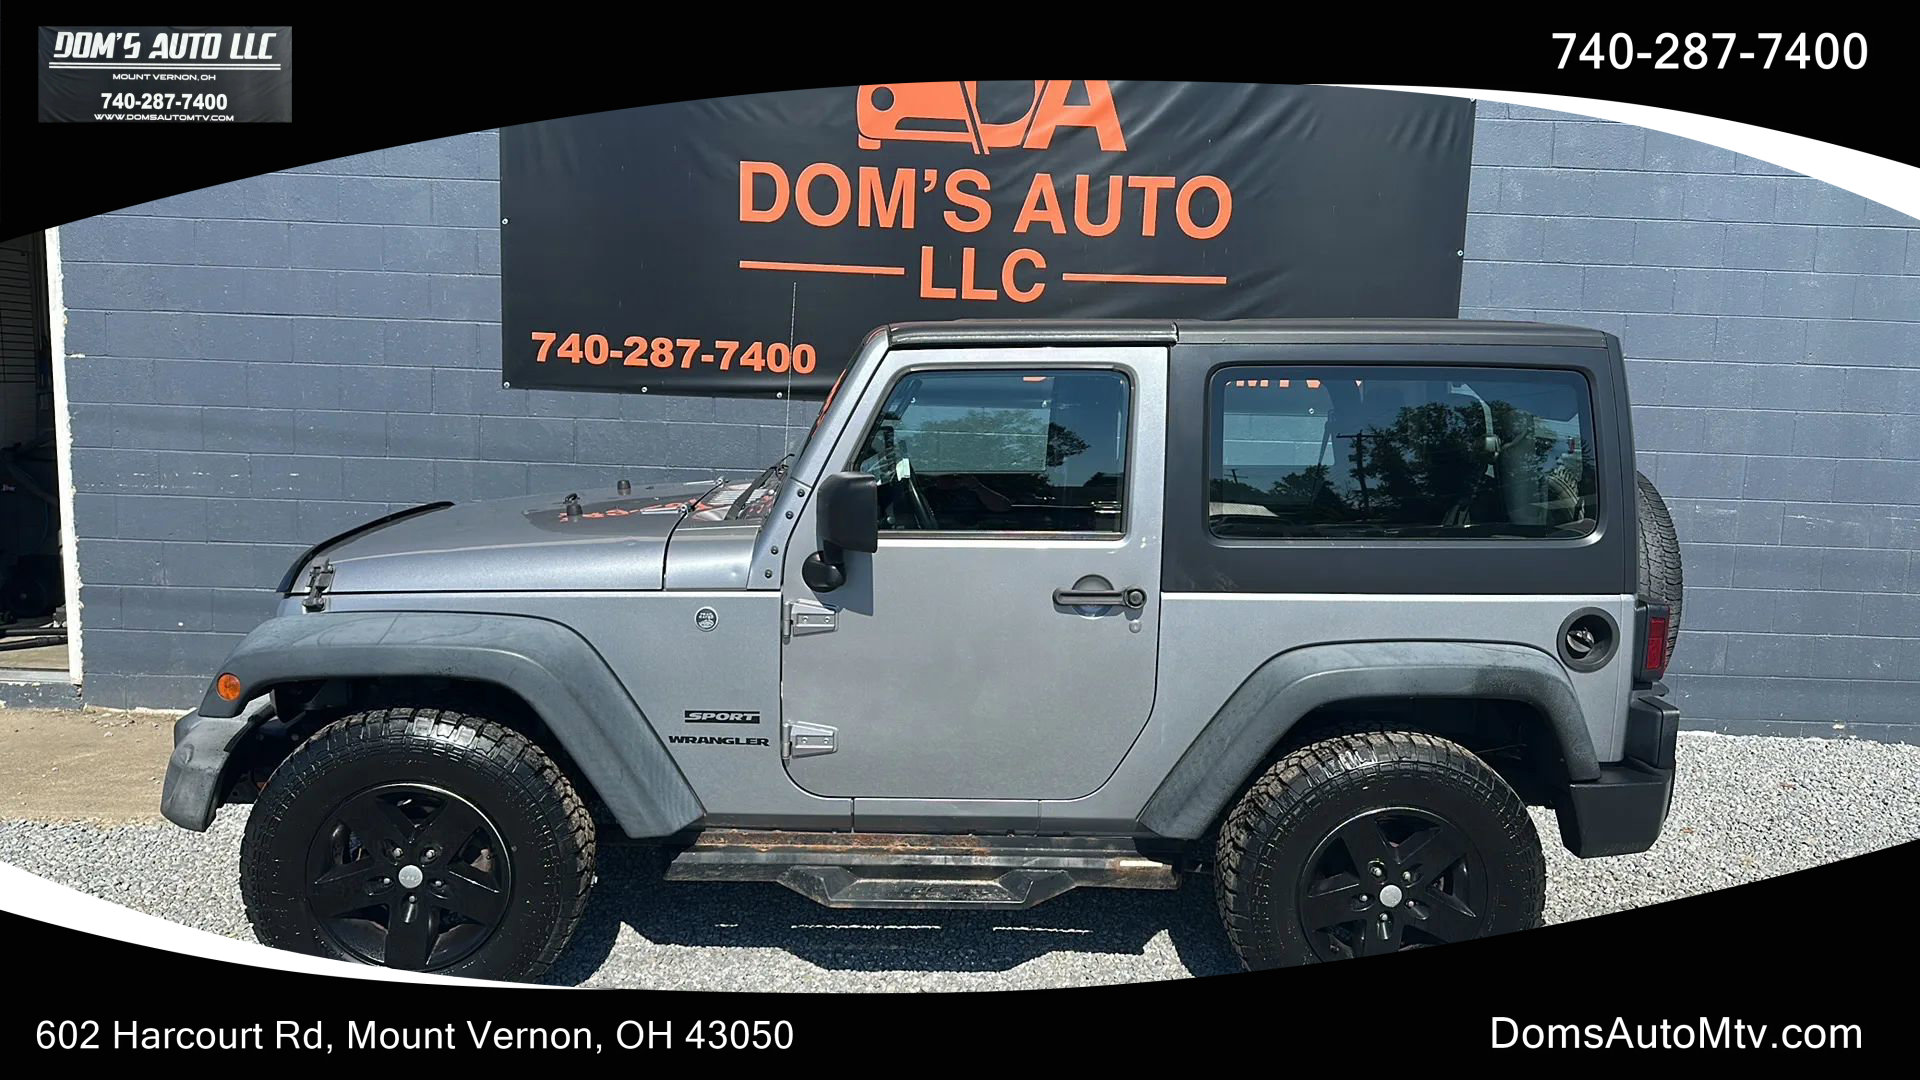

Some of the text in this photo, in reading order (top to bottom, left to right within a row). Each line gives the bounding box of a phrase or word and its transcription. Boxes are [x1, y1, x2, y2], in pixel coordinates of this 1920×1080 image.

[739, 160, 1233, 240] DOM'S AUTO
[920, 245, 1047, 303] LLC
[531, 331, 817, 375] 740-287-7400
[686, 712, 760, 721] SPORT
[668, 736, 770, 746] WRANGLER
